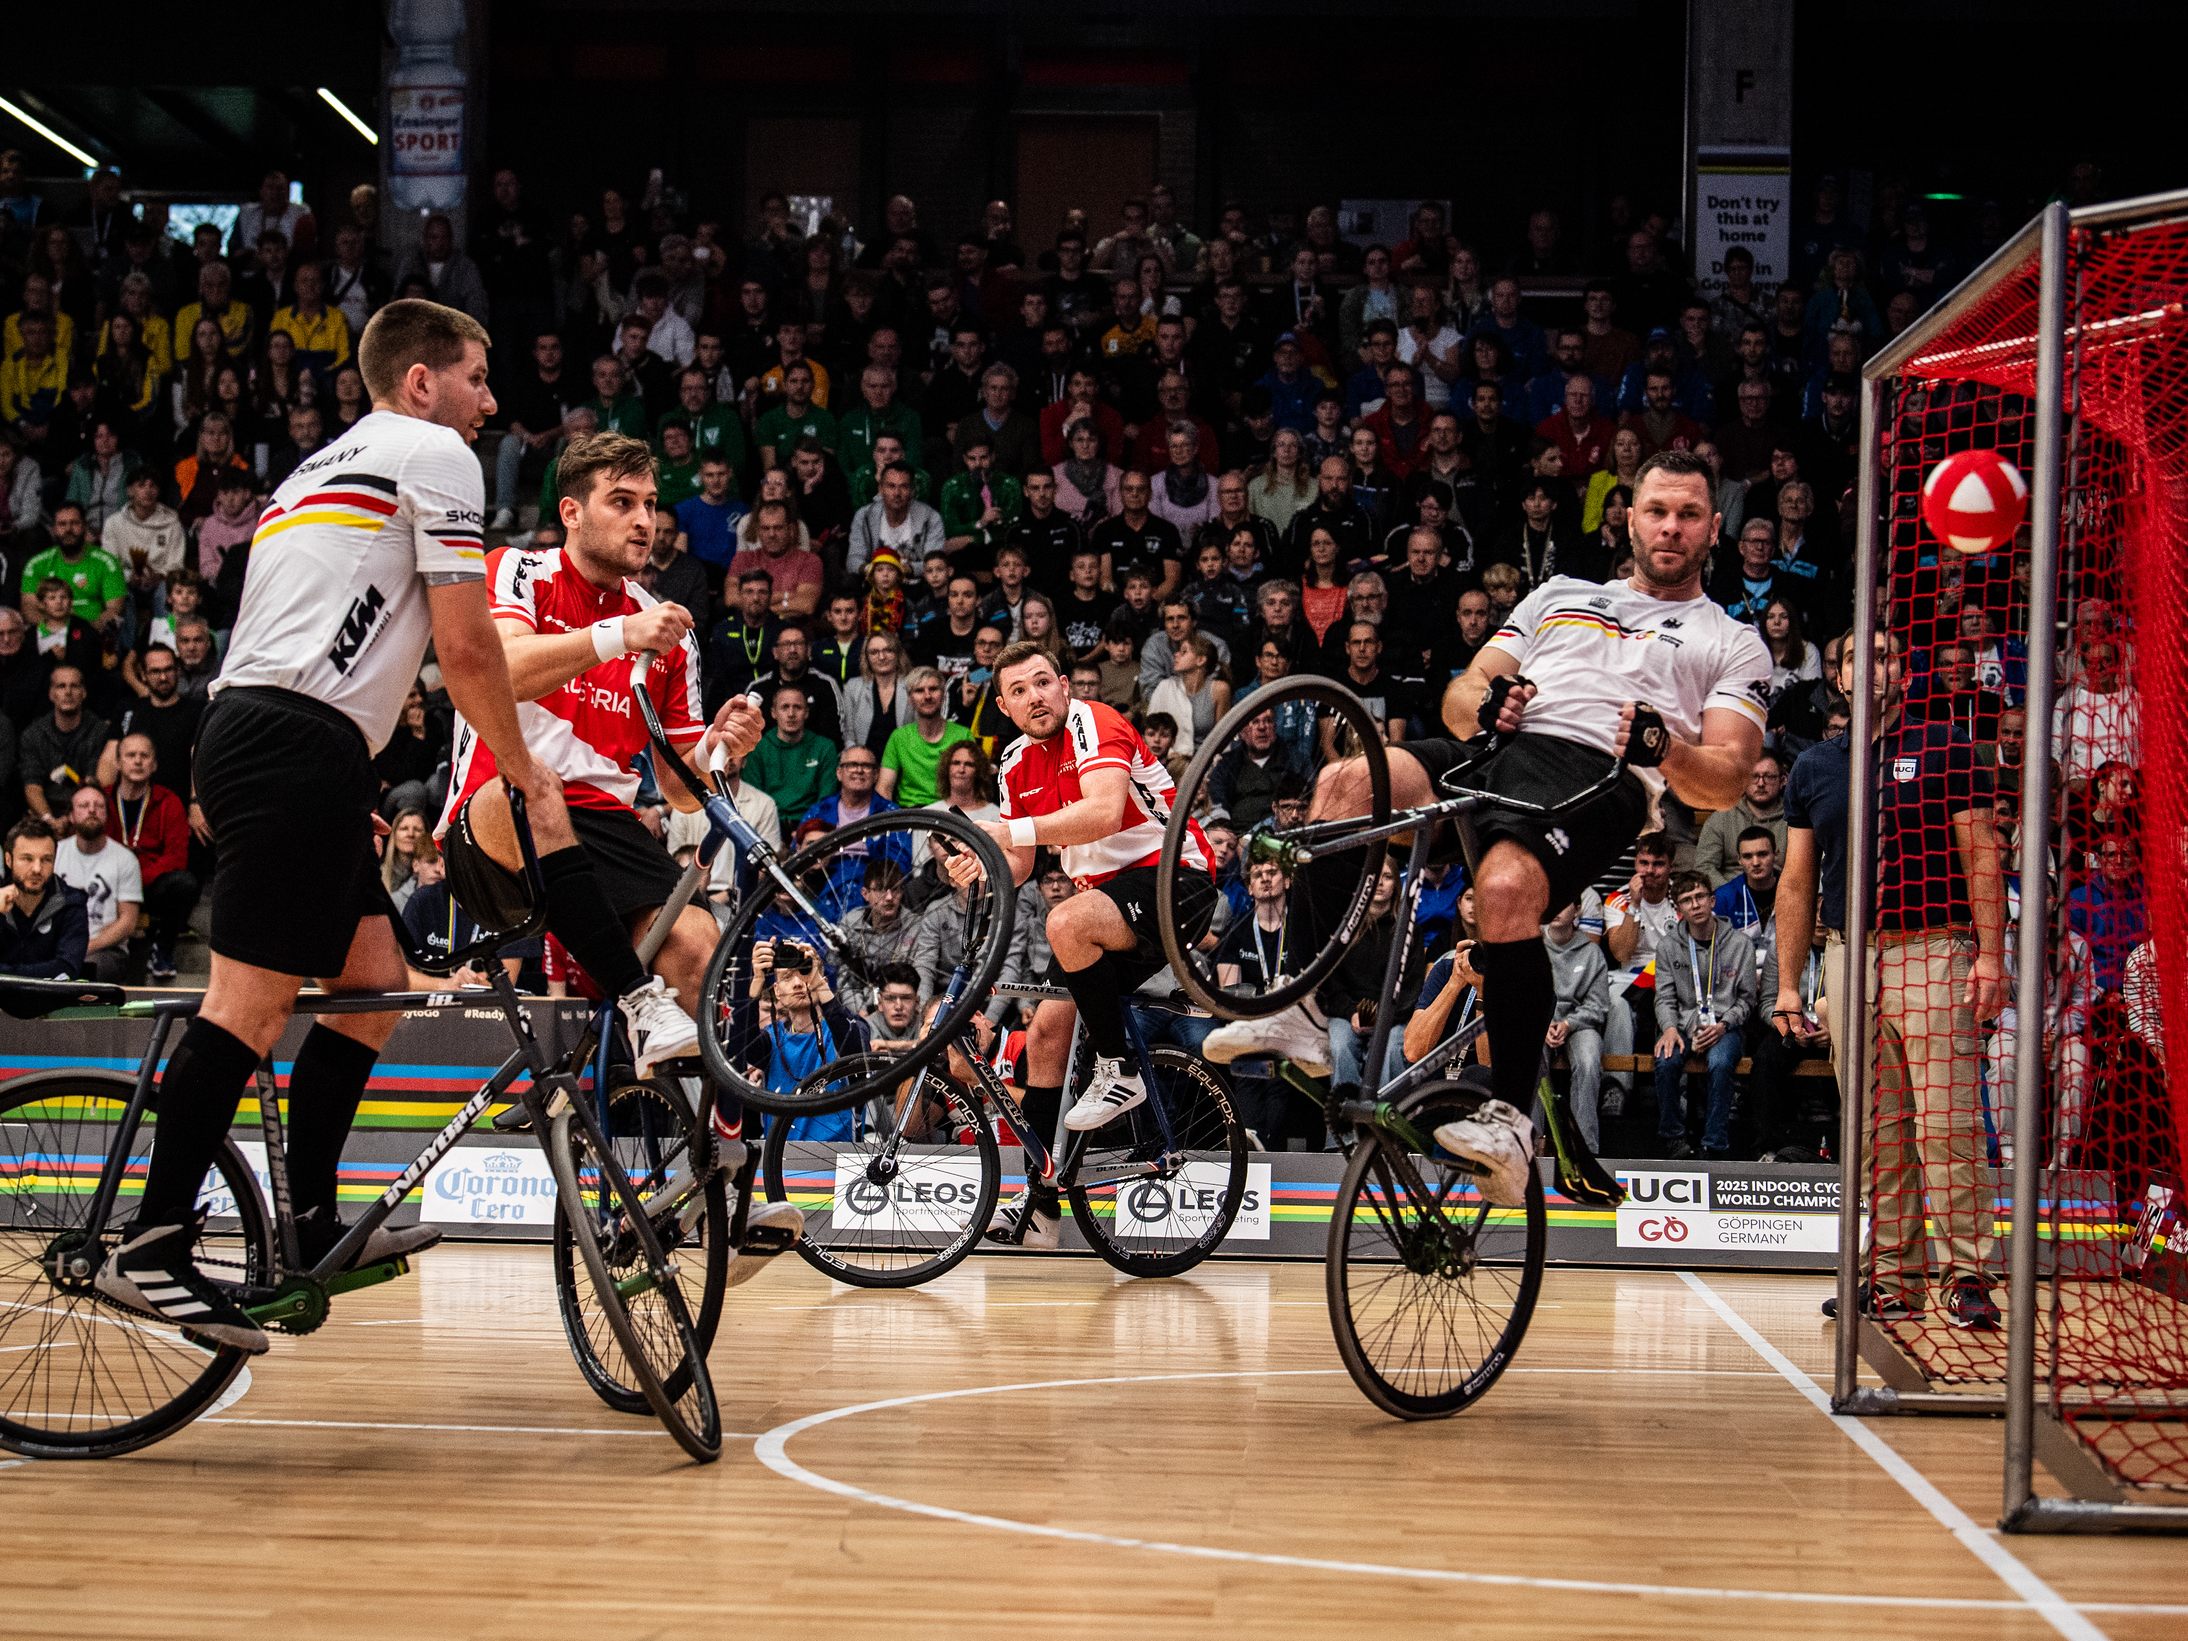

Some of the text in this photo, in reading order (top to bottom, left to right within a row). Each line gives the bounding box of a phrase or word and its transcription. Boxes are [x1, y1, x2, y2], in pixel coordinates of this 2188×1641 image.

[1736, 70, 1754, 103] F
[395, 133, 460, 152] SPORT
[1707, 195, 1780, 214] Don't try
[1717, 211, 1769, 226] this at
[1719, 228, 1766, 242] home
[328, 584, 386, 675] KTM
[1000, 983, 1064, 995] DURATEC
[435, 1166, 558, 1205] Corona
[897, 1182, 977, 1205] LEOS
[1632, 1178, 1701, 1204] UCI
[1716, 1180, 1748, 1191] 2025
[1752, 1181, 1809, 1193] INDOOR
[471, 1197, 526, 1220] Cero
[1179, 1189, 1260, 1212] LEOS
[1716, 1194, 1770, 1206] WORLD
[1717, 1216, 1803, 1231] GÖPPINGEN
[1718, 1232, 1788, 1245] GERMANY
